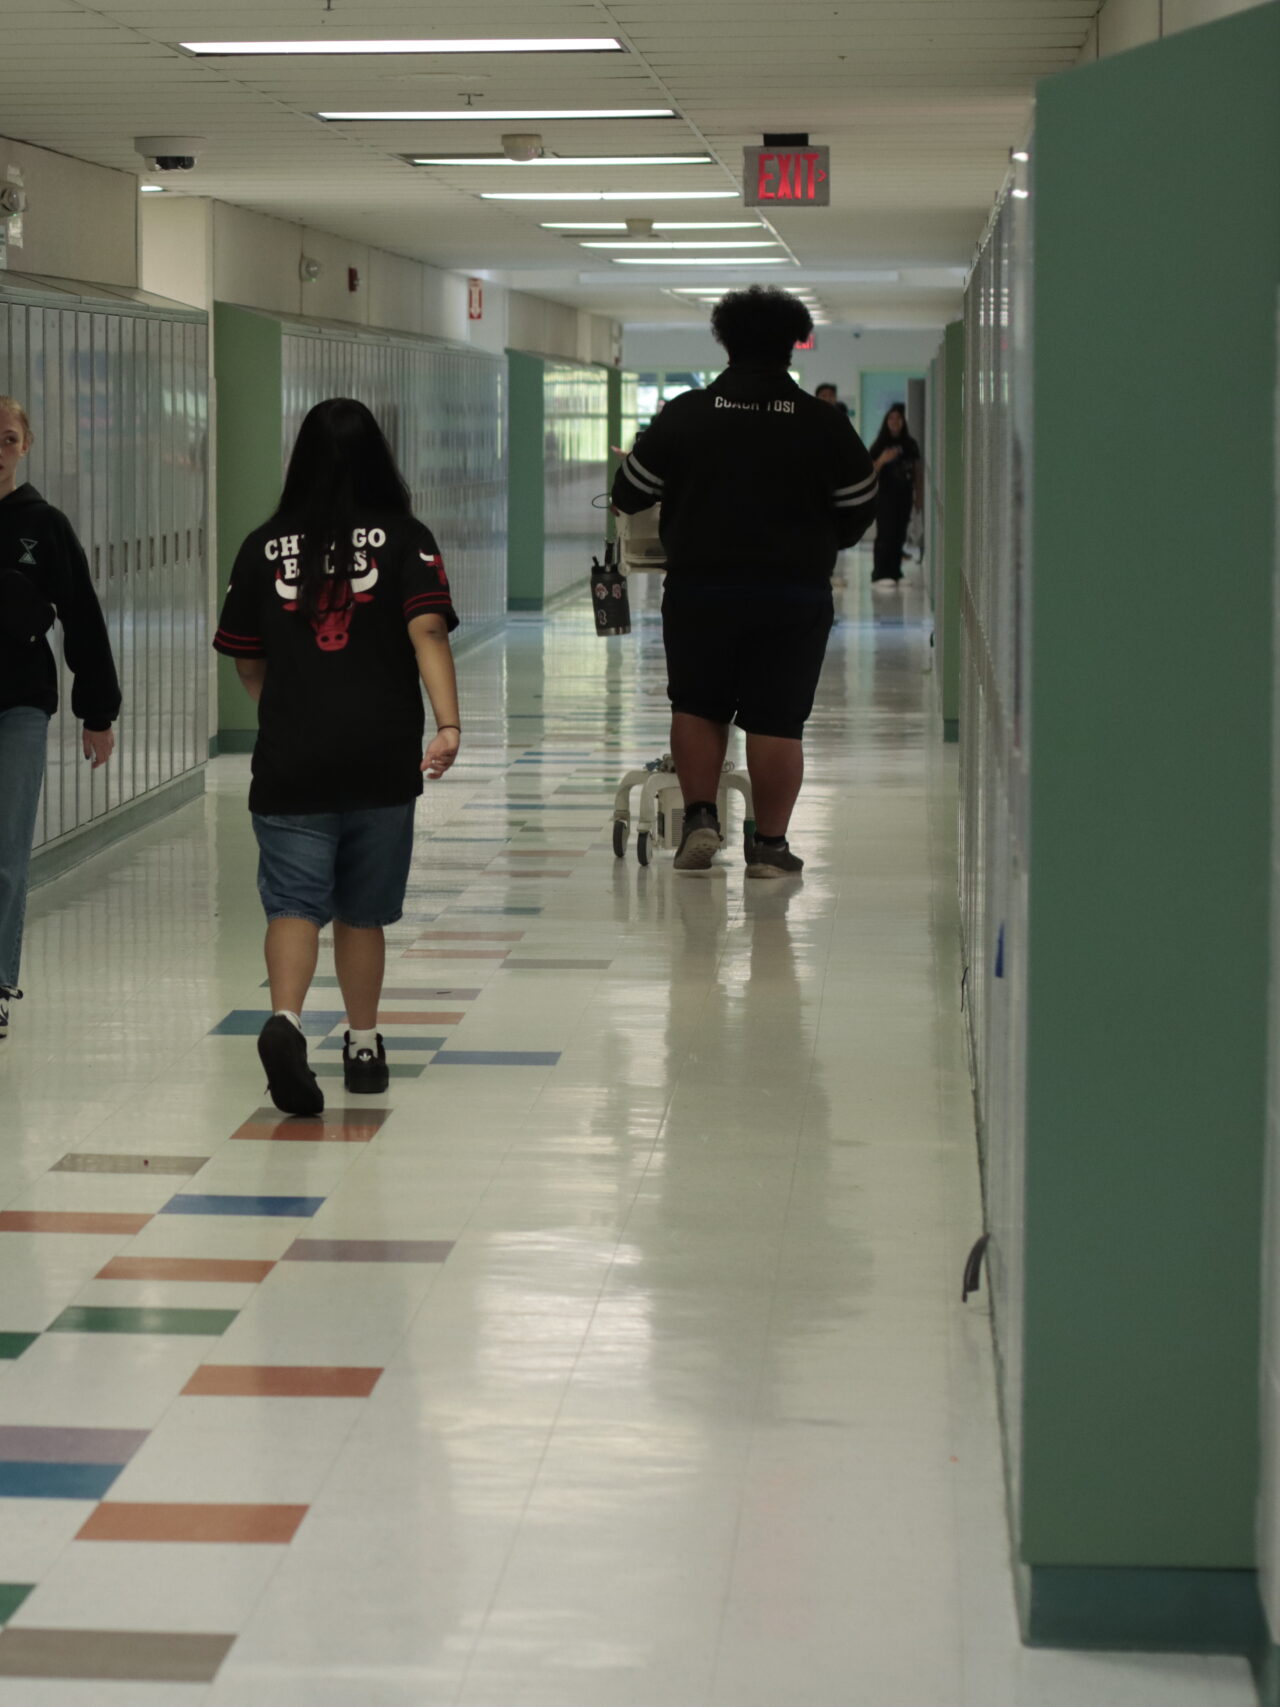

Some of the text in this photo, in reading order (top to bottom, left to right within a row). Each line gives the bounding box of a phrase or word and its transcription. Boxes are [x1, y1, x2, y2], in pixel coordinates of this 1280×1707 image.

[758, 153, 819, 200] EXIT
[264, 528, 386, 560] CHGO
[283, 550, 368, 580] BLS
